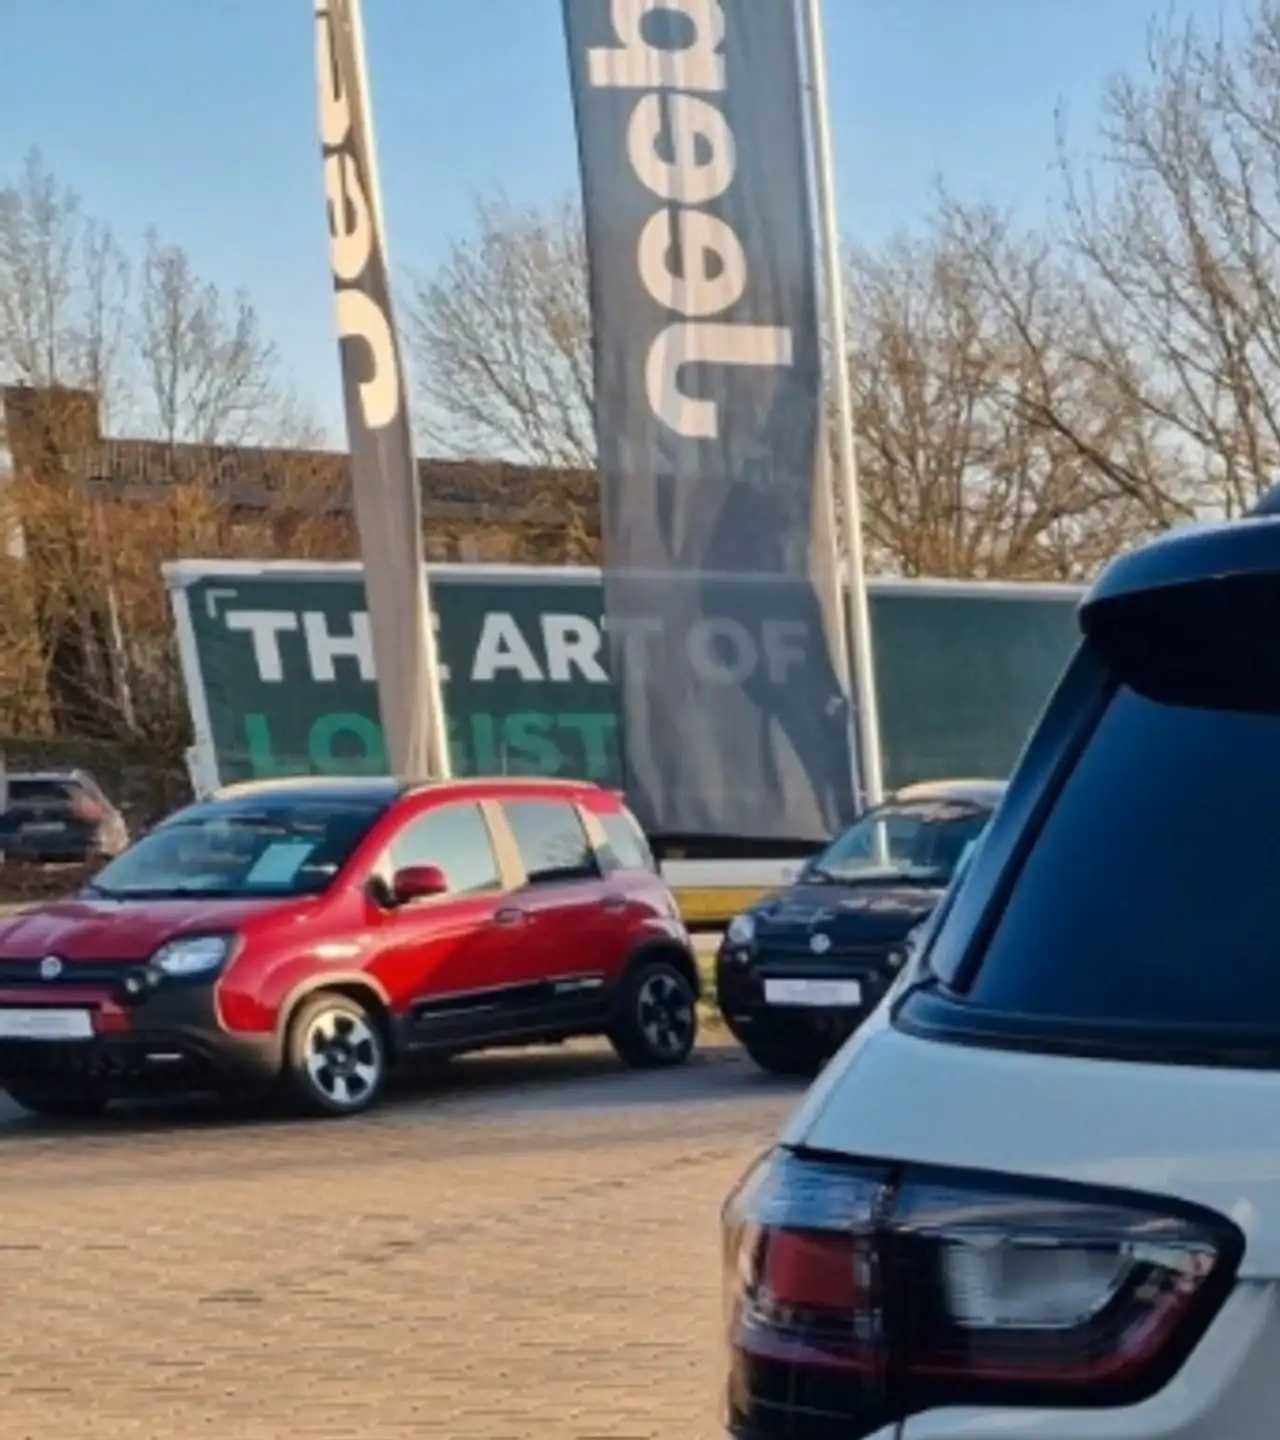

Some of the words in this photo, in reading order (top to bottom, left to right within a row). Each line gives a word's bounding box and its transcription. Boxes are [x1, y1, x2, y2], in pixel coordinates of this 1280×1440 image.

[225, 610, 451, 683] TH
[471, 611, 663, 684] ART
[686, 616, 809, 684] OF
[244, 710, 617, 776] LOIST
